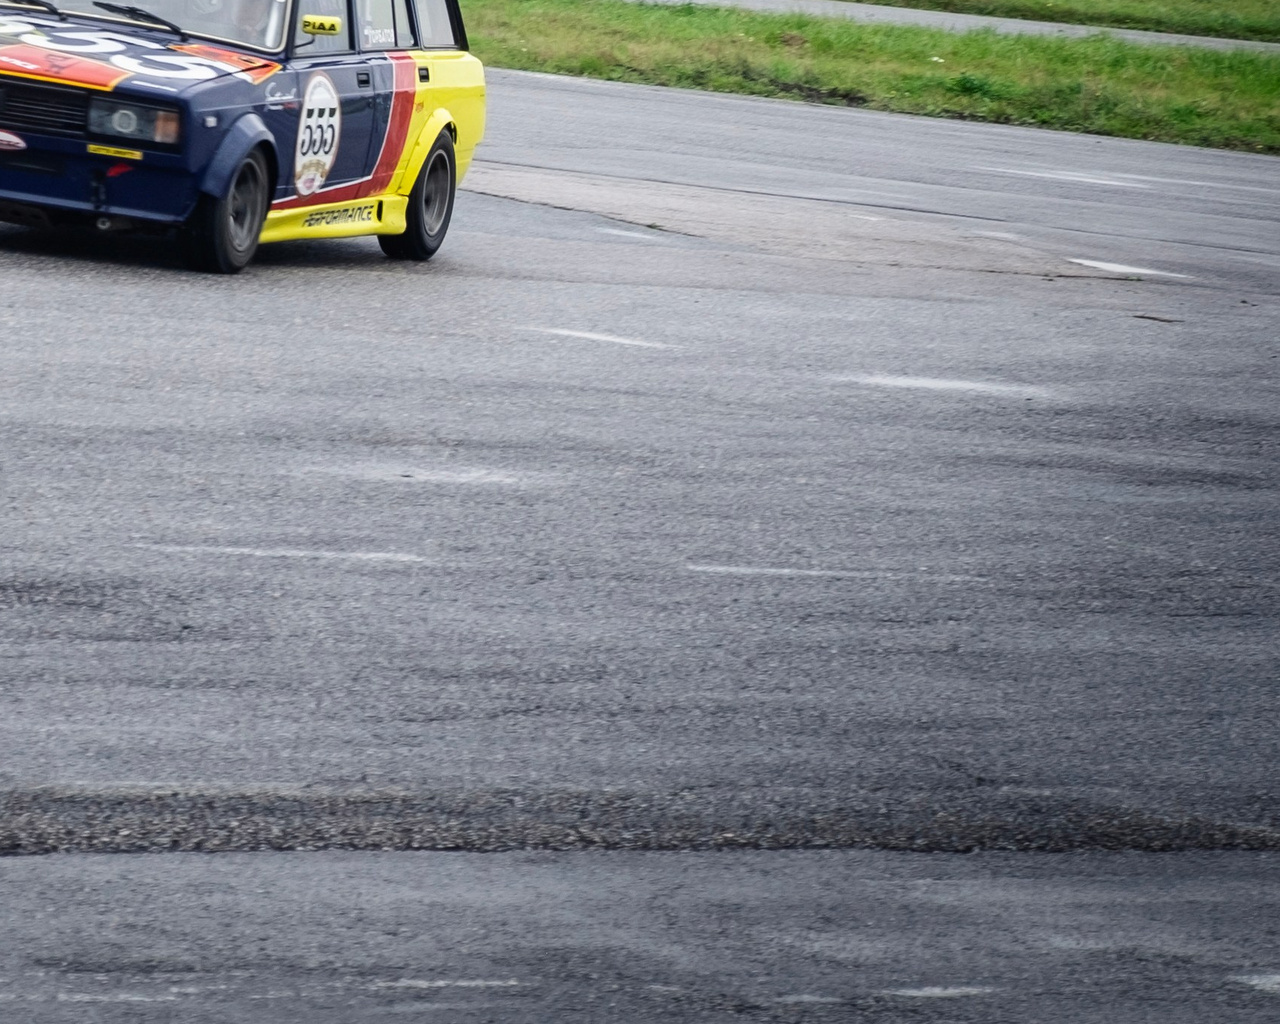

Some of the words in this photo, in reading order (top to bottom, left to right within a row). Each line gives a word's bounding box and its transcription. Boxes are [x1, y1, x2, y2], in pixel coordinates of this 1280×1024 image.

[302, 20, 338, 32] PIAA
[300, 107, 338, 156] 555
[302, 204, 376, 227] PERFORMANCE
